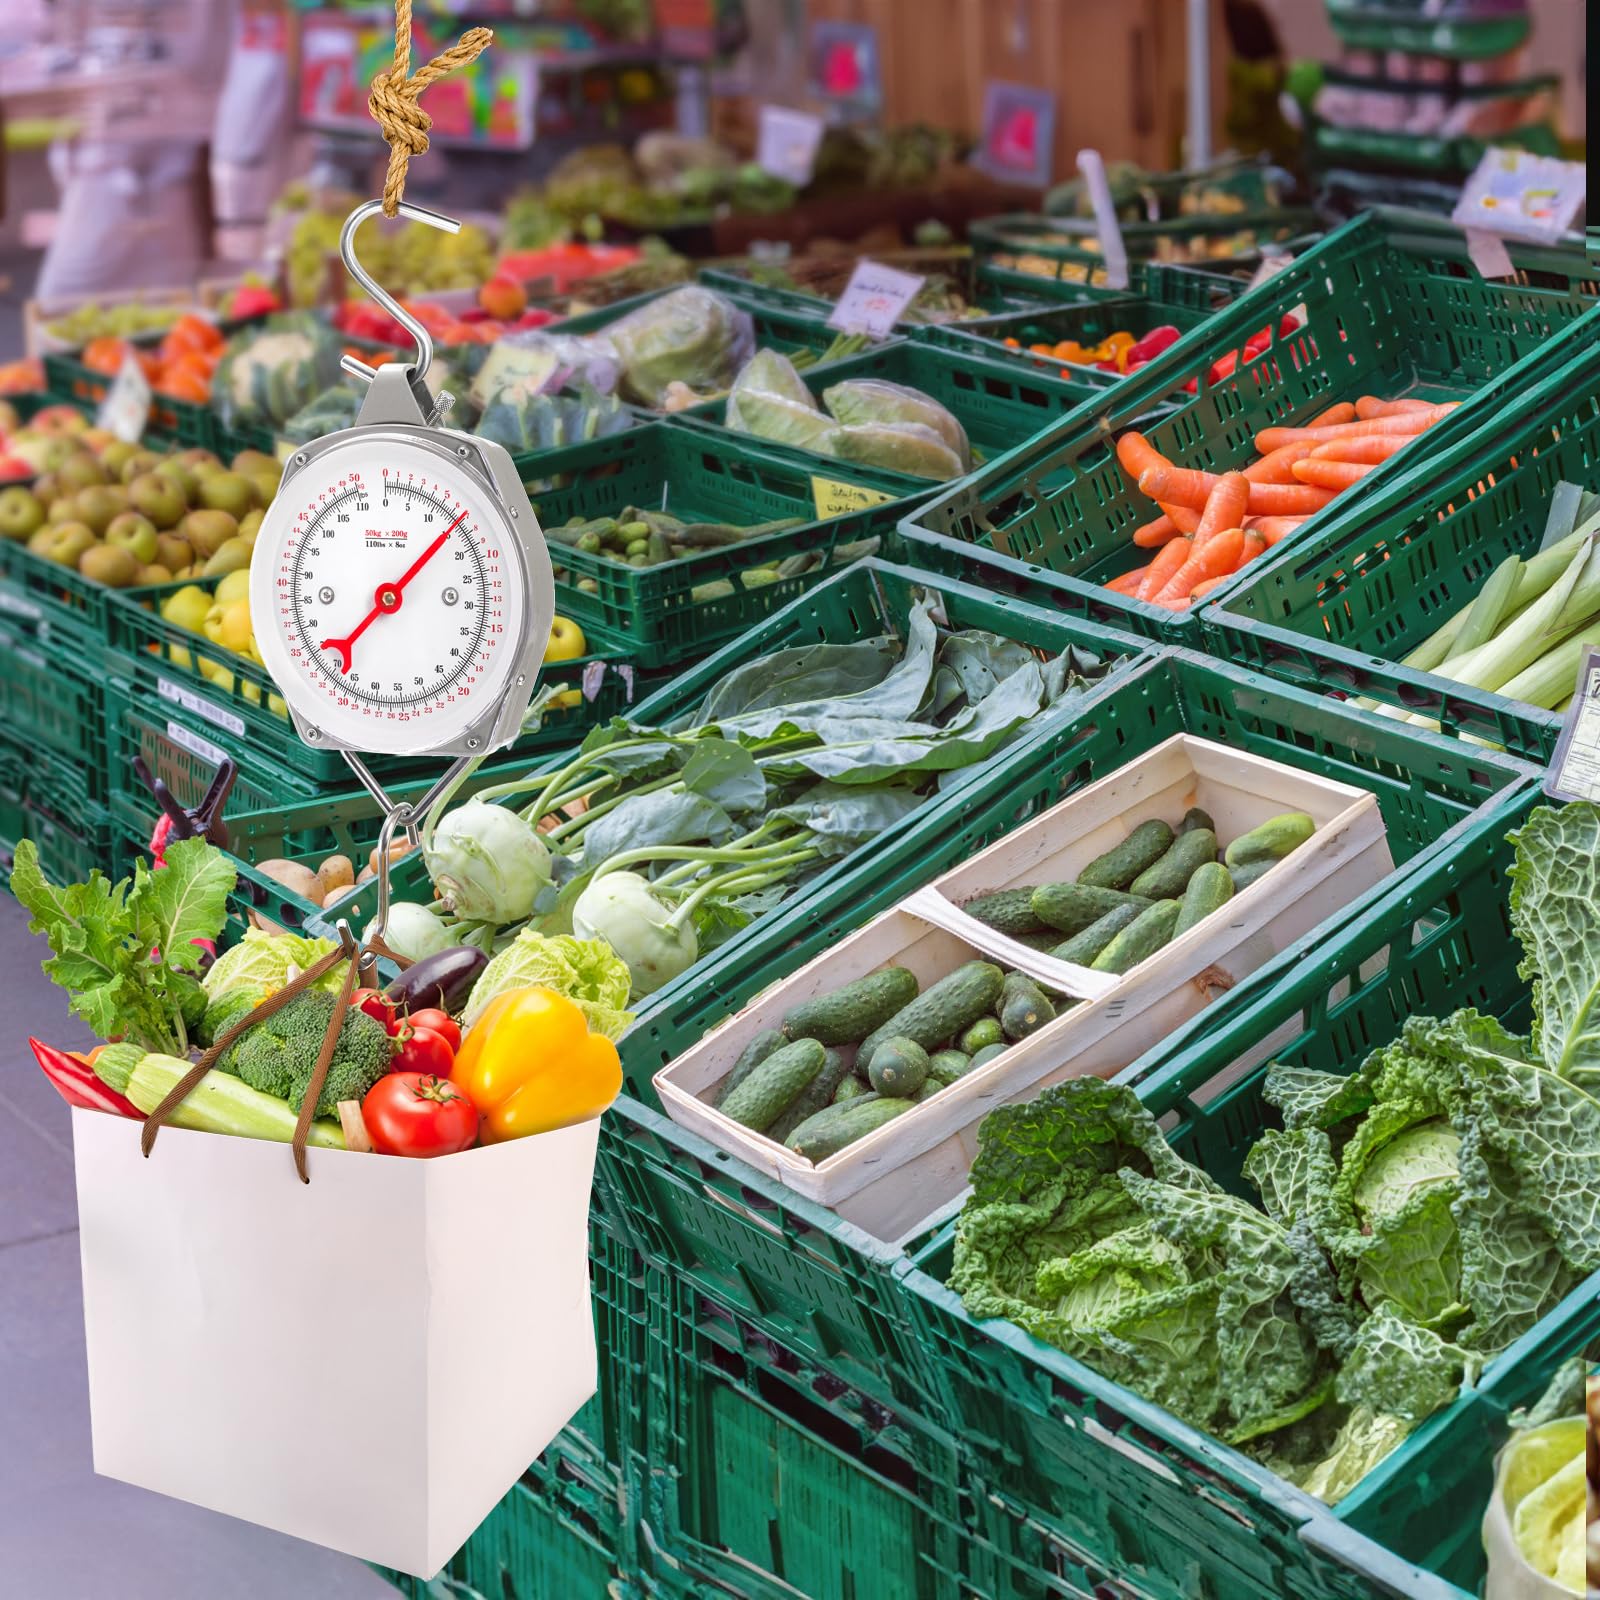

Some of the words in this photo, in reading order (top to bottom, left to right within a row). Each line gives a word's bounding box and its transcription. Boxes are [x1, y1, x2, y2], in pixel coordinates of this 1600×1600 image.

[383, 468, 388, 477] 0
[349, 474, 360, 482] 50
[445, 490, 450, 499] 5
[383, 498, 389, 507] 0
[356, 503, 369, 511] 110
[405, 503, 411, 511] 5
[337, 514, 350, 522] 105
[424, 514, 433, 522] 10
[322, 530, 334, 538] 100
[365, 529, 381, 538] 50kg
[311, 548, 320, 556] 95
[455, 552, 464, 560] 20
[487, 549, 498, 558] 10
[304, 572, 313, 580] 90
[463, 575, 472, 584] 25
[277, 578, 287, 586] 40
[304, 596, 313, 604] 85
[465, 601, 473, 610] 30
[309, 619, 318, 628] 80
[460, 627, 469, 635] 35
[491, 624, 503, 633] 15
[291, 649, 301, 657] 35
[450, 648, 459, 656] 40
[334, 659, 342, 667] 70
[435, 665, 444, 673] 45
[350, 673, 359, 681] 65
[414, 677, 424, 685] 50
[371, 682, 380, 690] 60
[394, 683, 402, 691] 55
[458, 687, 470, 695] 20
[338, 697, 348, 706] 30
[399, 712, 410, 721] 25
